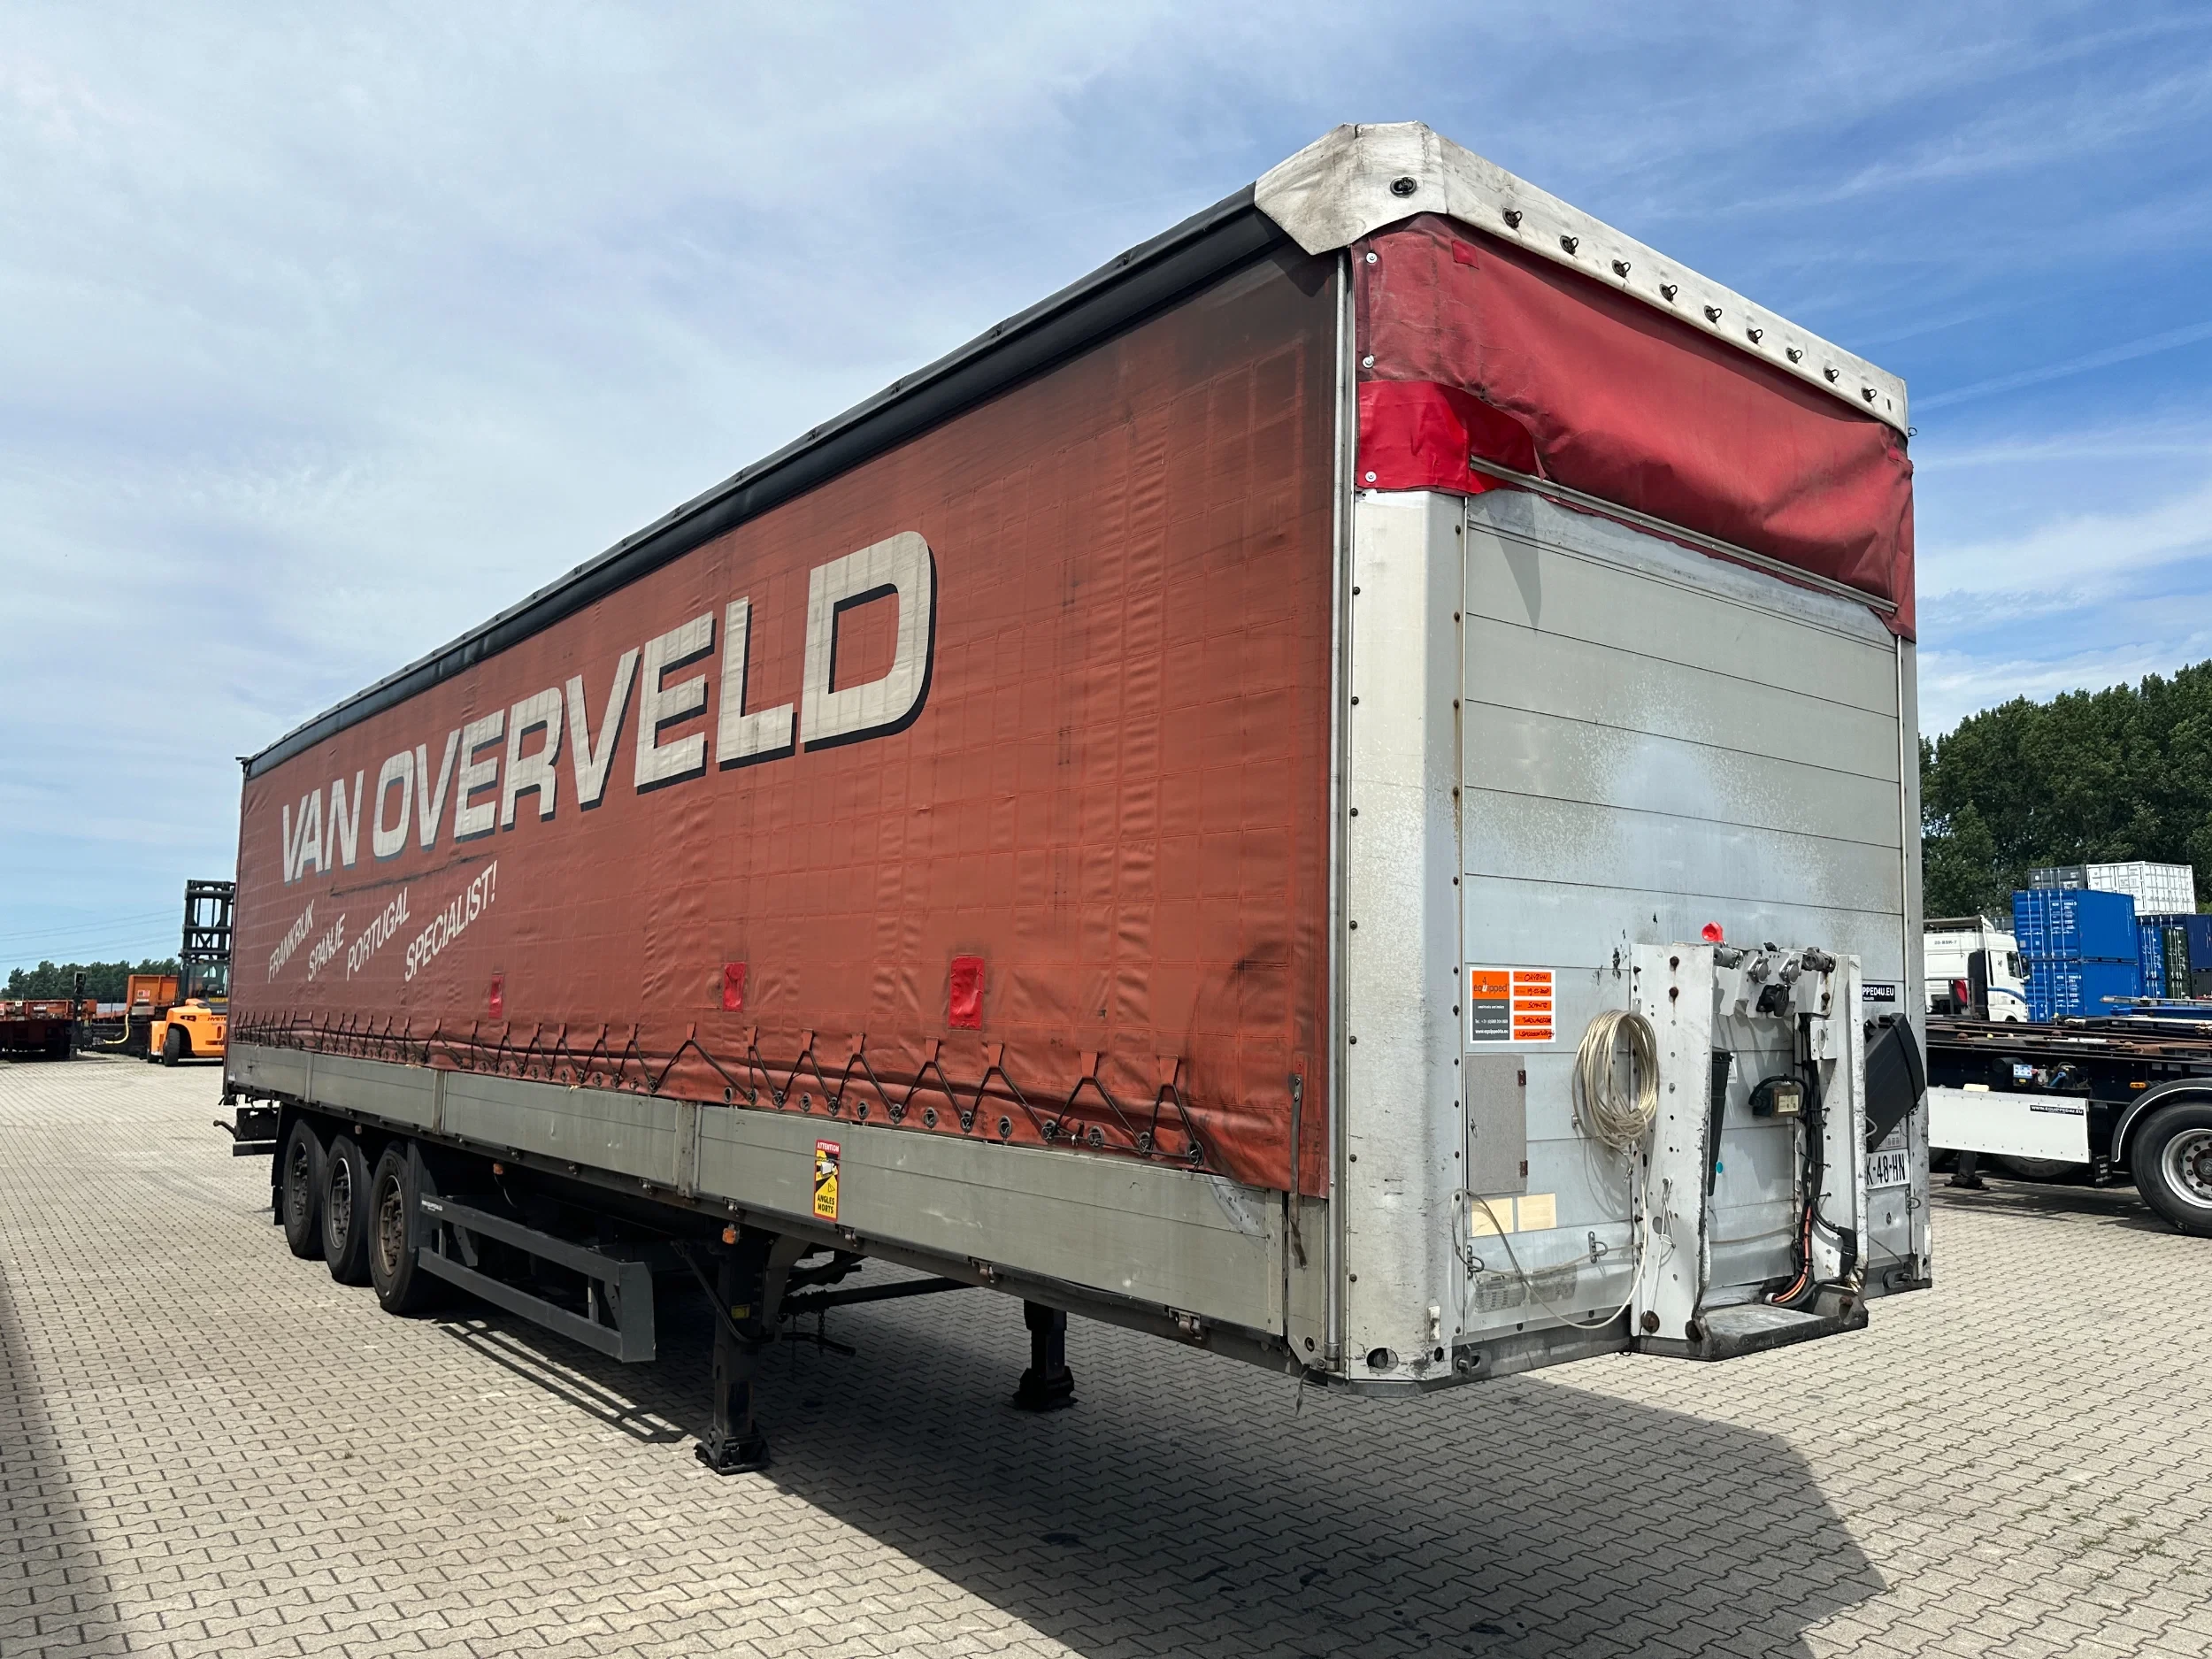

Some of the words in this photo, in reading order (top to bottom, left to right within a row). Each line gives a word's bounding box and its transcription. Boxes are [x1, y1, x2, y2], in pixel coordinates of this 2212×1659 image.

[282, 769, 365, 886] VAN
[372, 530, 936, 862] OVERVELD
[268, 899, 315, 984] FRANKRIJK
[308, 913, 346, 982] SPANJE
[346, 887, 411, 981] PORTUGAL
[404, 859, 498, 982] SPECIALIST!
[817, 1141, 840, 1152] ATTENTION
[817, 1194, 835, 1205] ANGLES
[818, 1203, 834, 1214] MORTS
